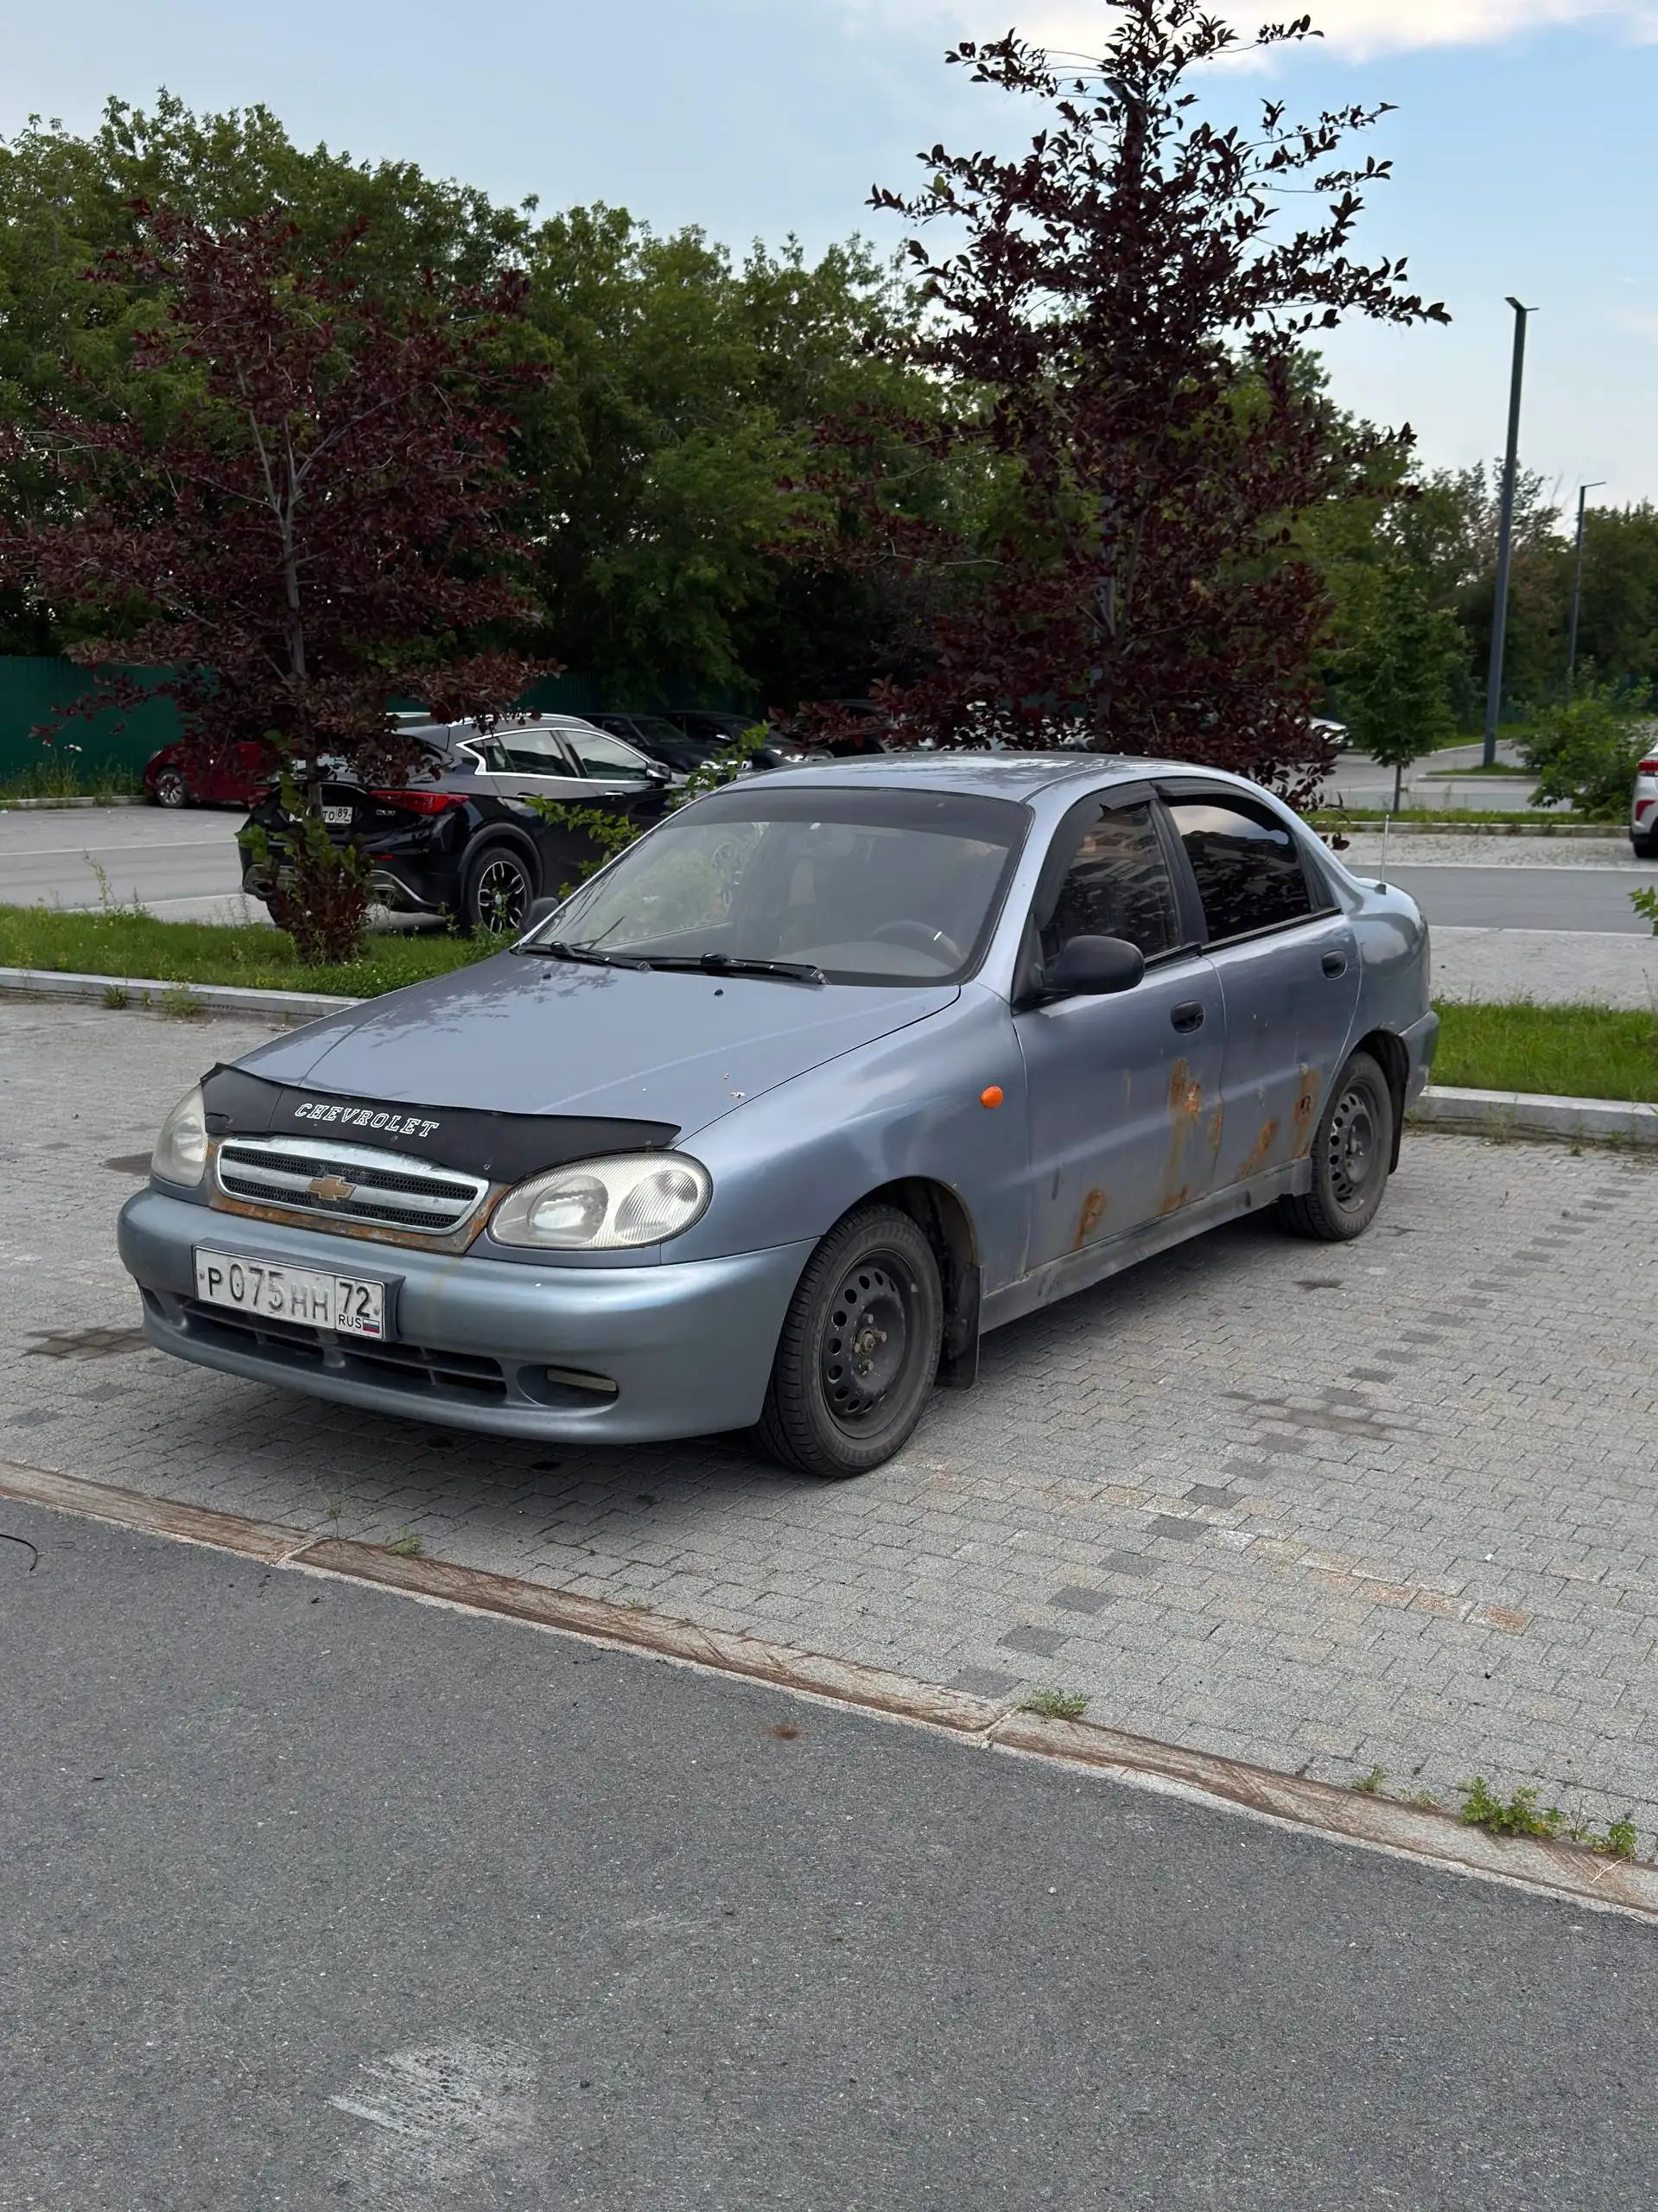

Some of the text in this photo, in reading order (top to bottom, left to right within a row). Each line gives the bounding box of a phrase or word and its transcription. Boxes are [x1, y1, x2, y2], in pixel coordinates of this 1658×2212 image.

[294, 1103, 440, 1138] CHEVROLET
[340, 1281, 371, 1319] 72
[338, 1313, 362, 1329] RUS
